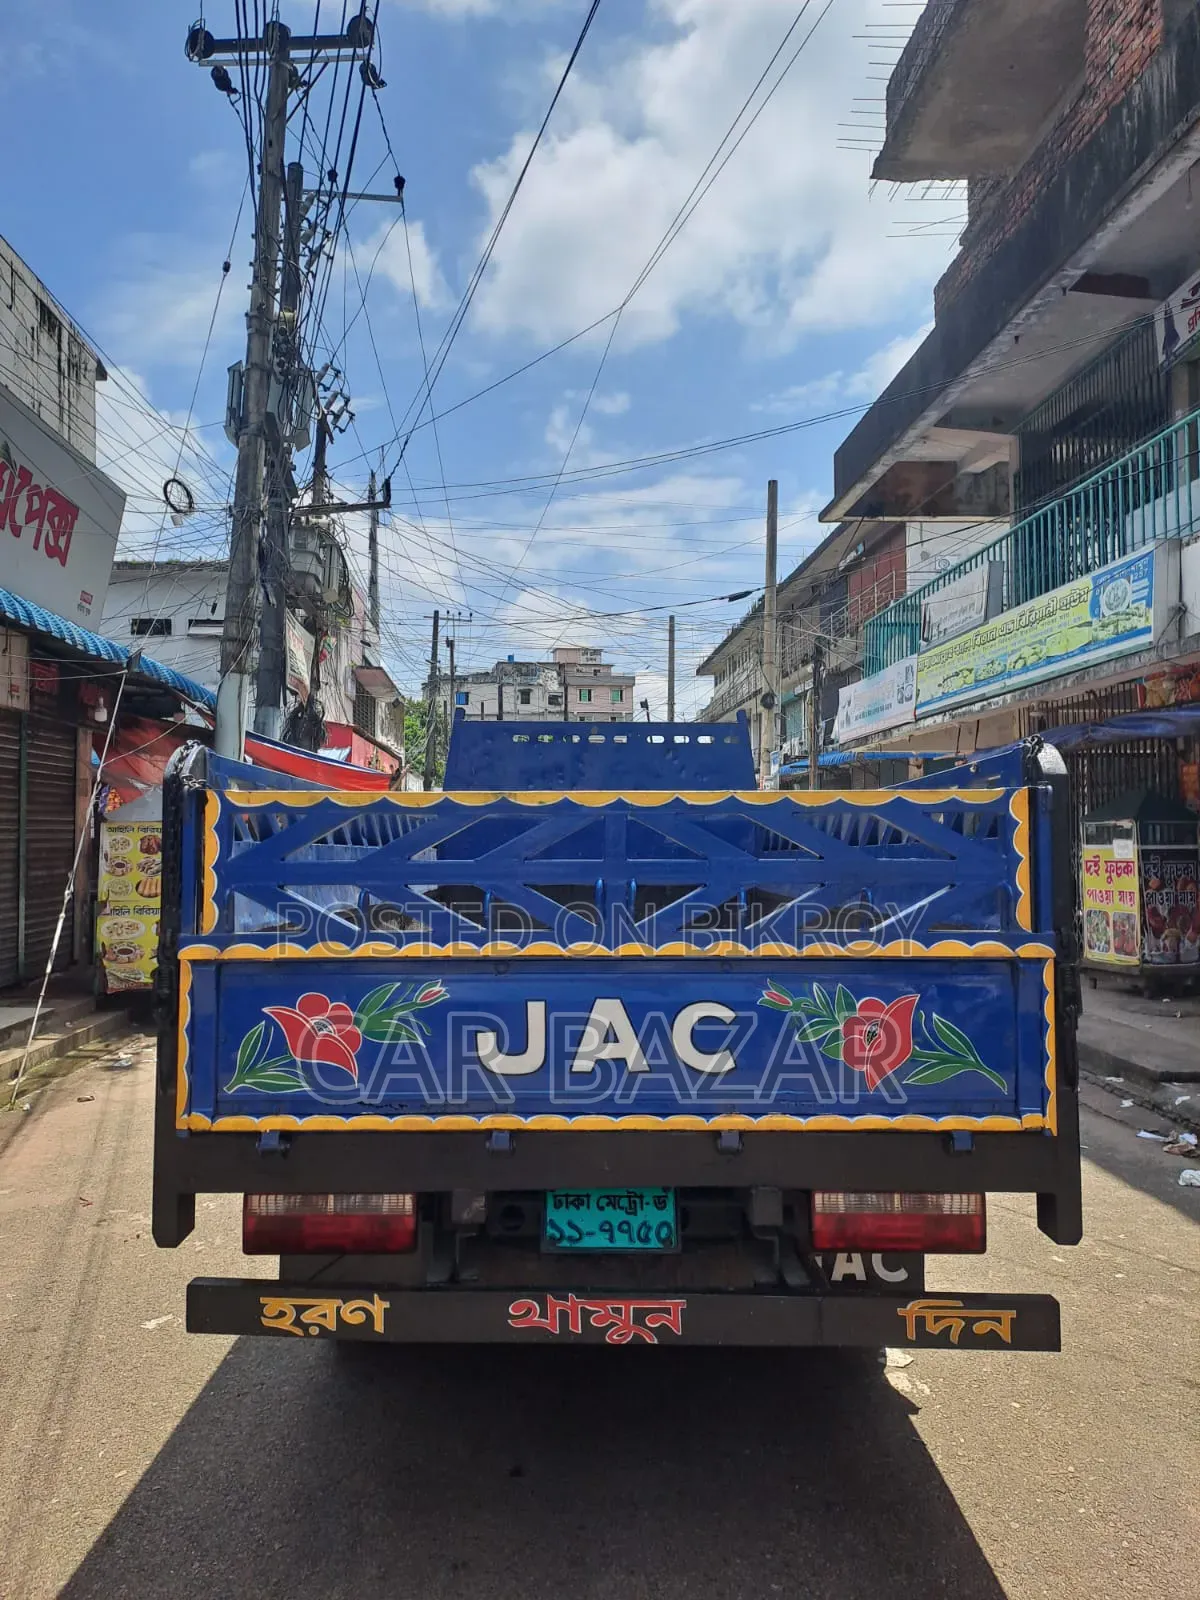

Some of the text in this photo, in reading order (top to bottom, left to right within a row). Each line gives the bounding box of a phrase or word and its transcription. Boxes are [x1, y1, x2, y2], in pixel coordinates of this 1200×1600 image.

[1084, 854, 1136, 885] দই ফুচকা
[1086, 888, 1136, 907] পাওয়া যায়
[476, 997, 738, 1076] JAC
[552, 1192, 591, 1211] ঢাকা
[547, 1218, 673, 1246] ১১-৭৭৫০
[815, 1253, 909, 1283] AC
[259, 1293, 1017, 1346] হরণ থামুন দিন
